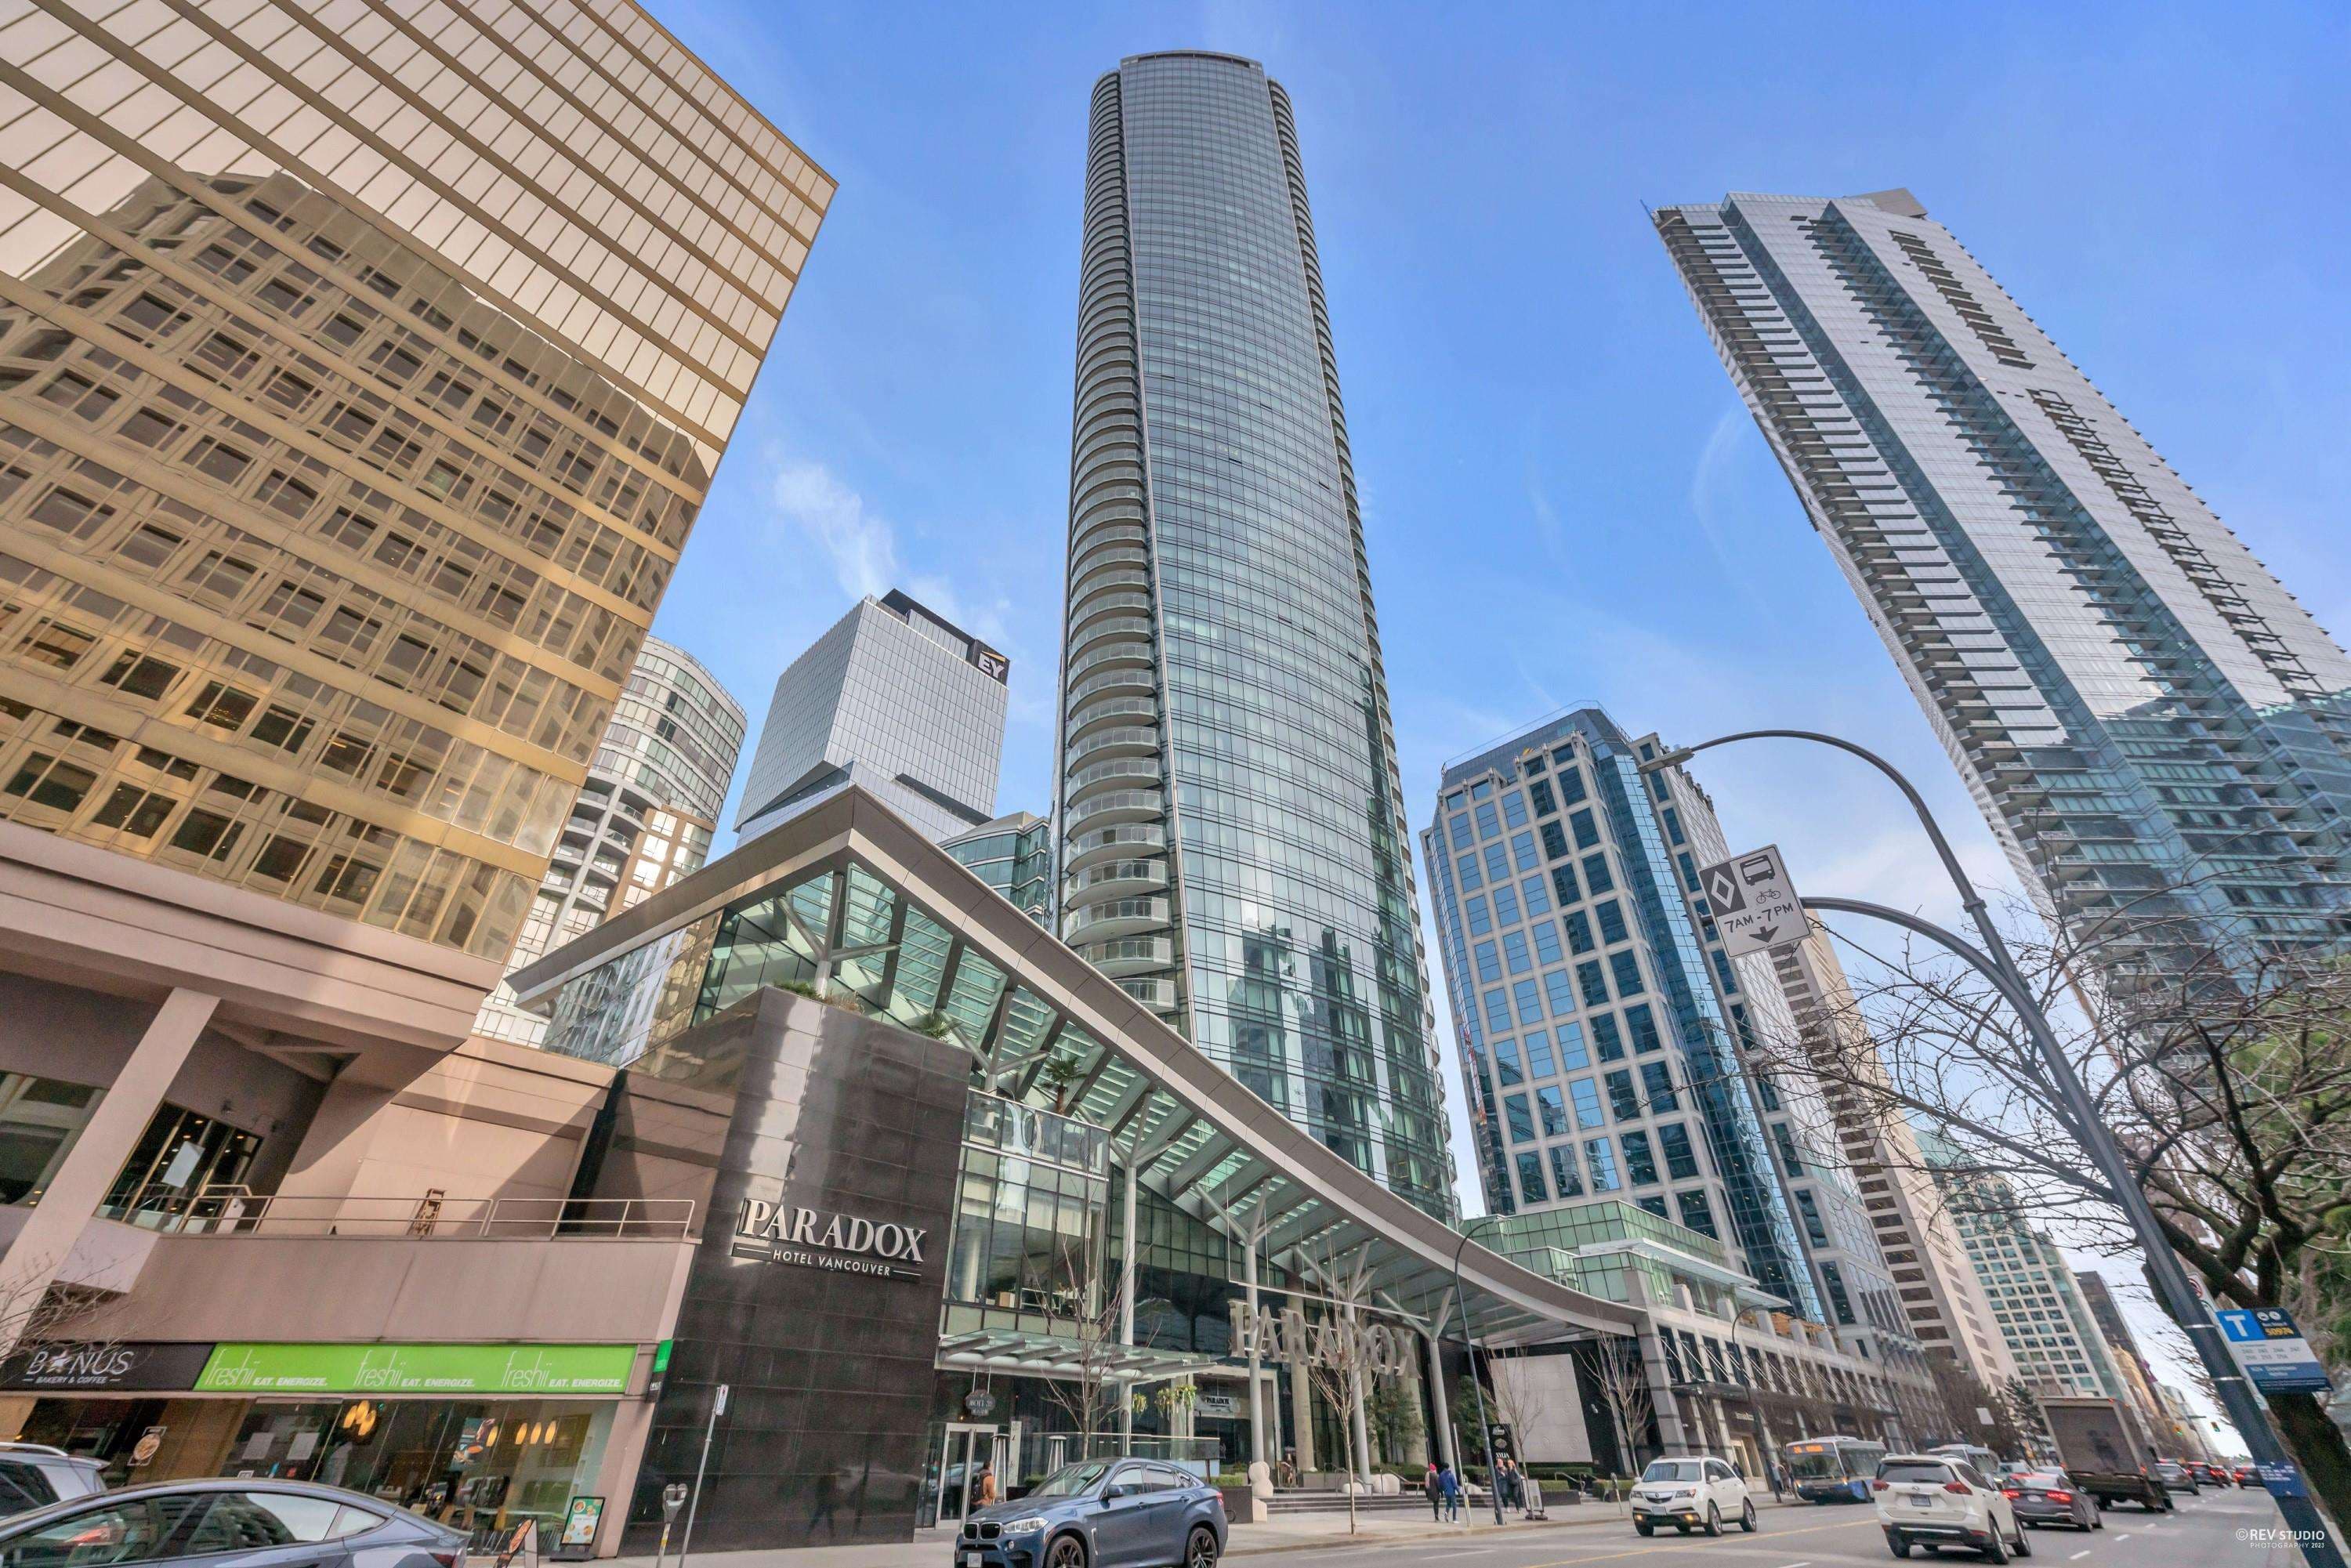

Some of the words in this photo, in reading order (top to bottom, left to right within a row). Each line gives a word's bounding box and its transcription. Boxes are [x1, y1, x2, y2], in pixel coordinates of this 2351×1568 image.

[978, 653, 1005, 679] EY
[1724, 914, 1754, 932] 7AM
[741, 1199, 927, 1262] PARADOX
[773, 1249, 812, 1265] HOTEL
[818, 1255, 890, 1276] VANCOUVER
[1227, 1298, 1423, 1380] PARADOX
[2224, 1315, 2248, 1337] T
[26, 1350, 134, 1375] BNUS
[205, 1348, 260, 1385] freshii
[253, 1377, 274, 1386] EAT.
[276, 1377, 328, 1386] ENERGIZE.
[354, 1349, 407, 1387] freshii
[401, 1378, 422, 1387] EAT.
[425, 1378, 475, 1388] ENERGIZE.
[501, 1350, 552, 1387] freshii
[549, 1378, 570, 1388] EAT.
[572, 1378, 623, 1388] ENERGIZE.
